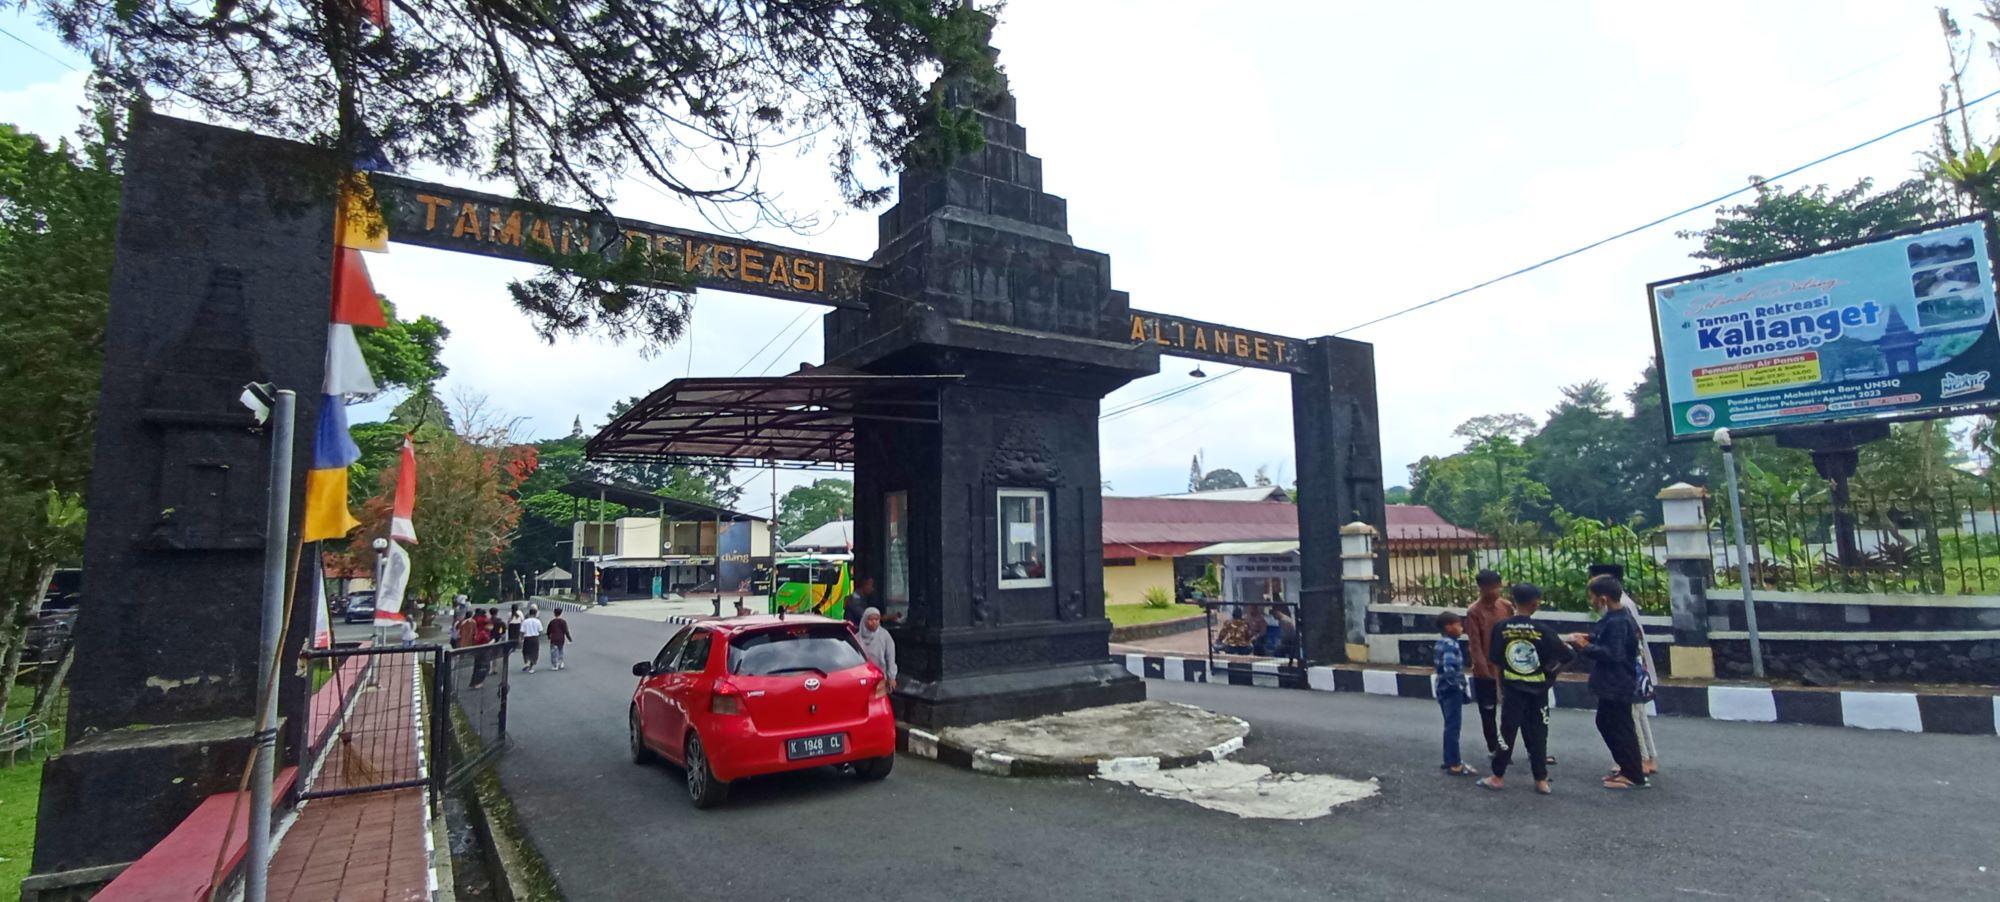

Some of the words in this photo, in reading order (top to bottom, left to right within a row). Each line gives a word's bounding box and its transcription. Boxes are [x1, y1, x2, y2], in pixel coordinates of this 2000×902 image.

[417, 194, 589, 256] TAMAN
[1697, 312, 1749, 328] Taman
[1755, 296, 1829, 318] Rekreasi
[1698, 301, 1879, 350] Kalianget
[1130, 314, 1286, 363] ALIANGET
[1726, 336, 1822, 358] Wonosobo
[1702, 363, 1754, 376] Pemandian
[1757, 359, 1771, 368] Air
[1773, 355, 1805, 366] Panas
[1727, 394, 1781, 406] Pendaftaran
[1784, 388, 1835, 400] Mahasiswa
[1838, 385, 1861, 393] Baru
[1864, 379, 1900, 390] UNSIQ
[1859, 389, 1881, 398] 2023
[791, 741, 797, 753] K
[804, 738, 823, 751] 1948
[830, 736, 840, 748] CL
